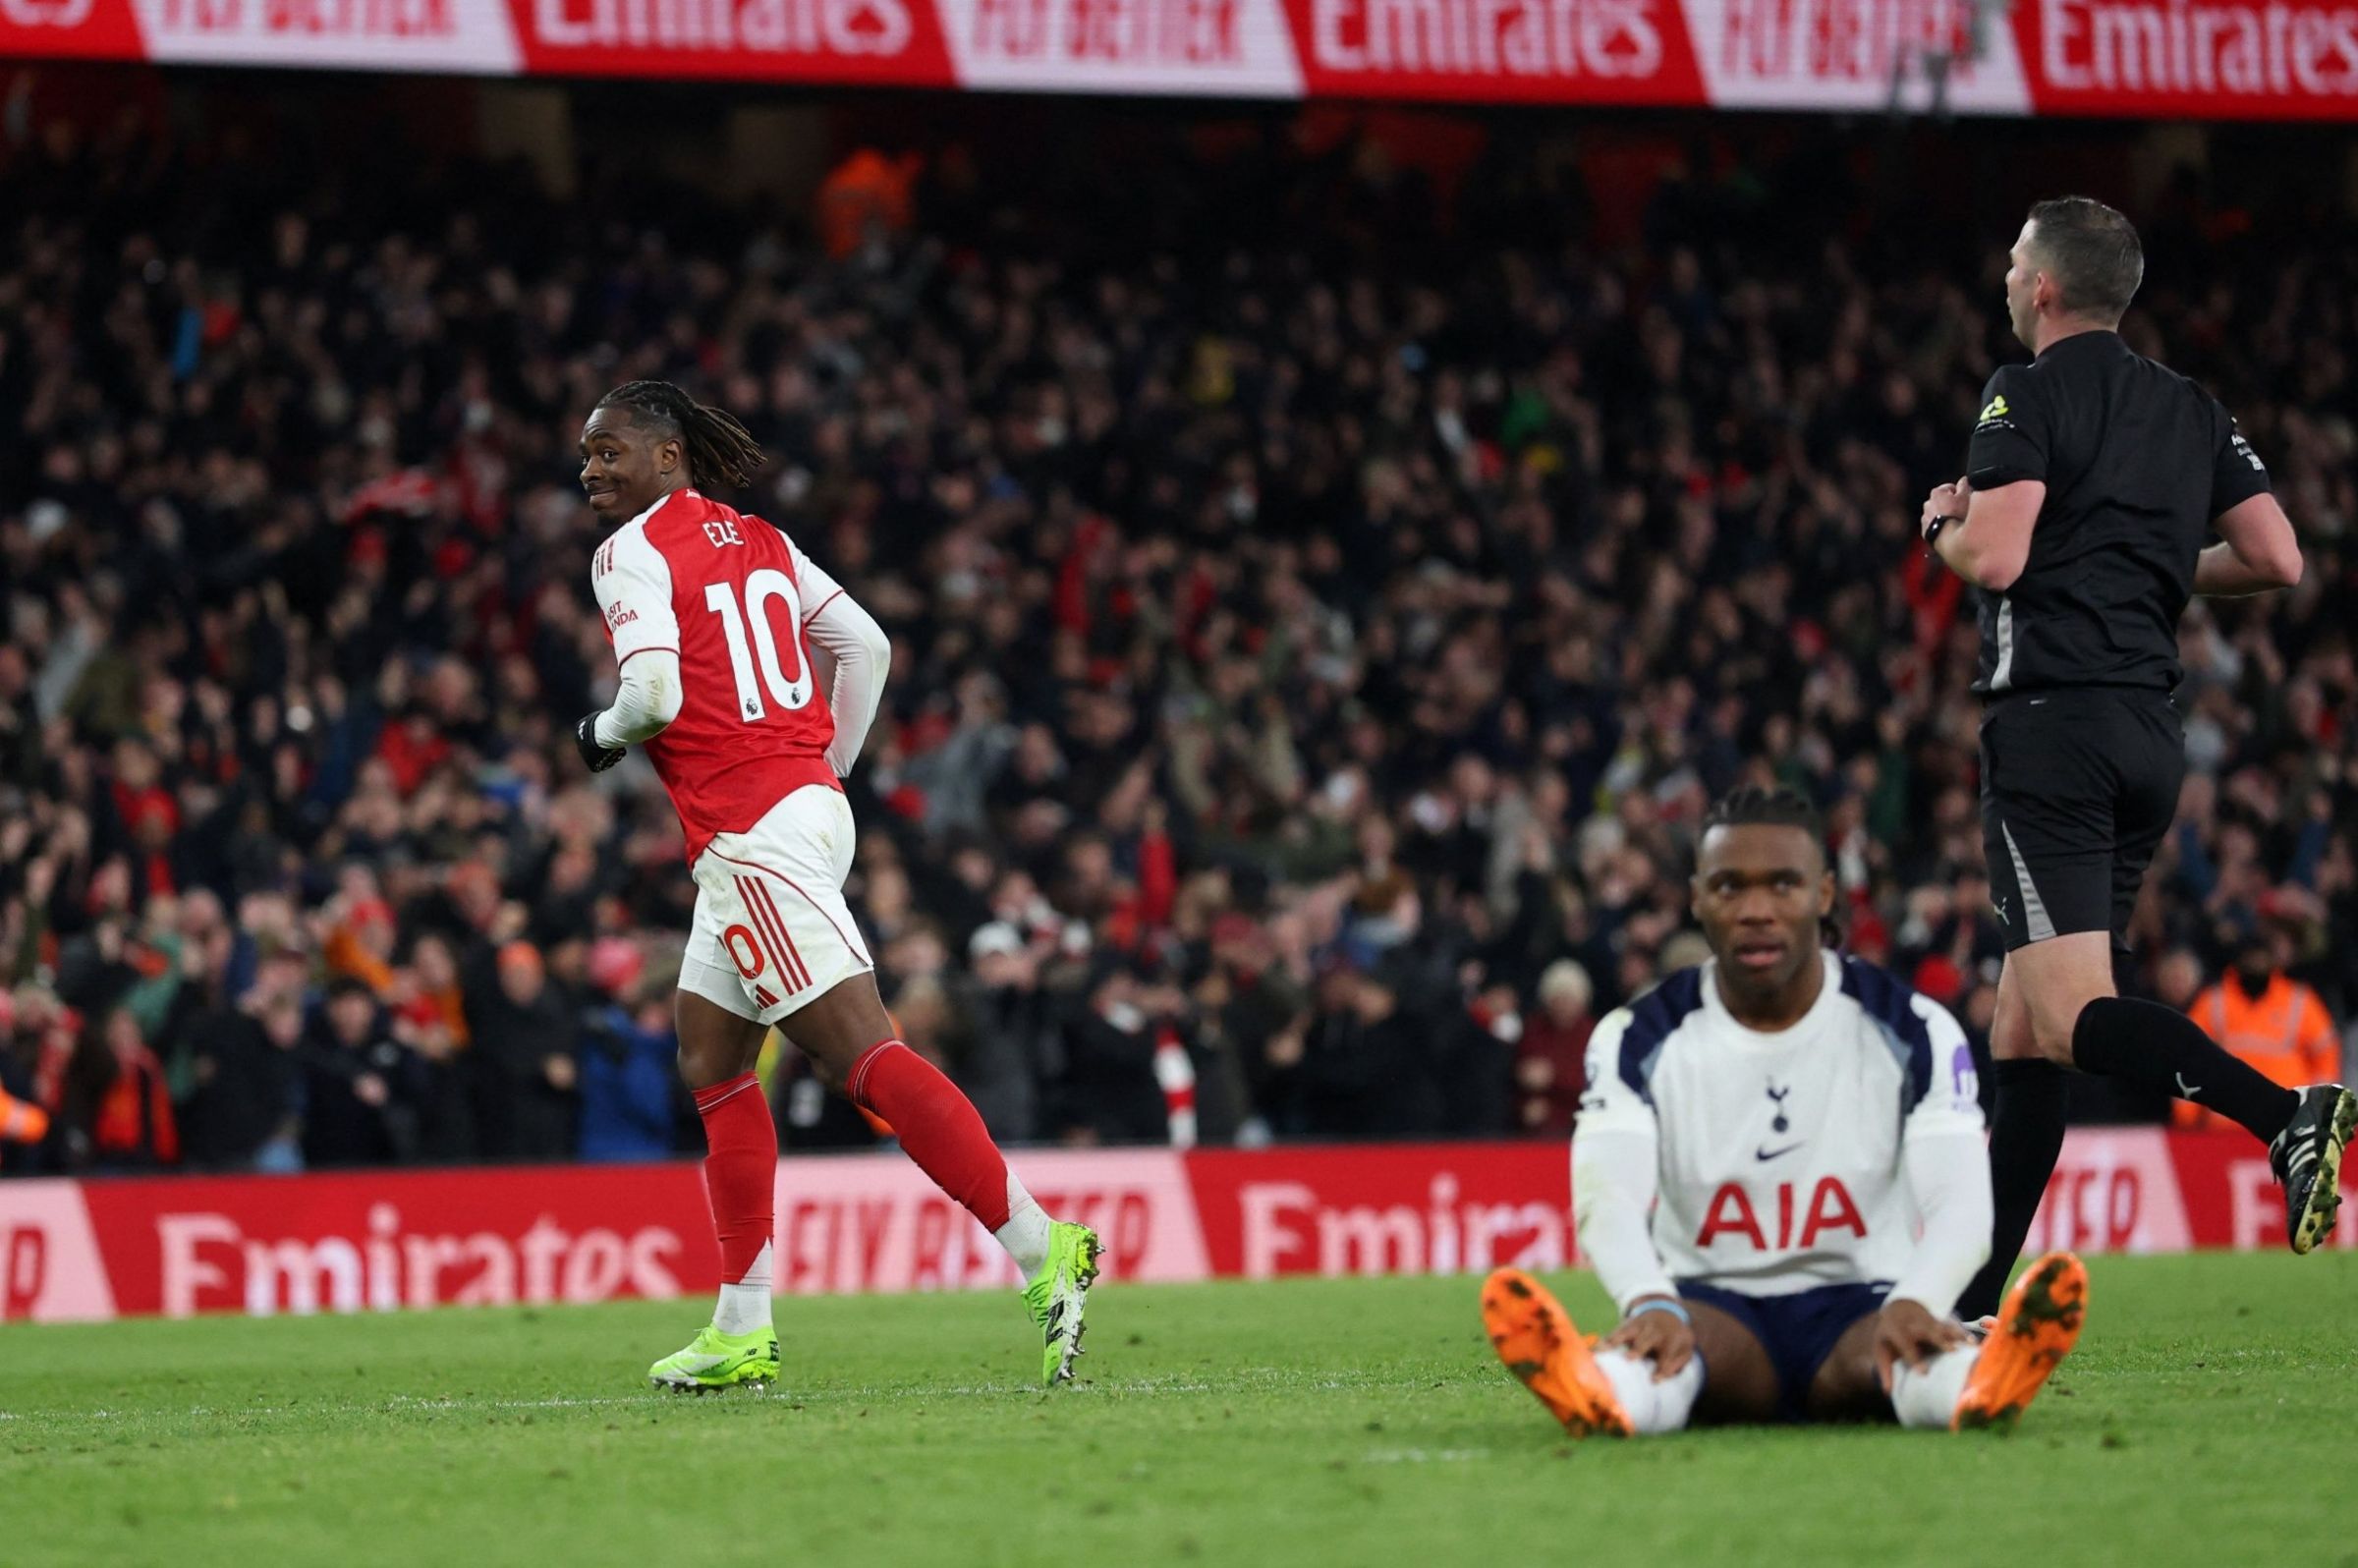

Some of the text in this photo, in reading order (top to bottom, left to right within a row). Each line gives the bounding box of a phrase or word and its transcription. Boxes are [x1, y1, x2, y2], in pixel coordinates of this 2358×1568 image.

[1312, 0, 1664, 78] Emirates
[2040, 0, 2358, 95] Emirates
[702, 520, 745, 549] EZE
[703, 567, 814, 723] 10
[1695, 1175, 1868, 1251] AIA
[156, 1202, 686, 1317] Emirates
